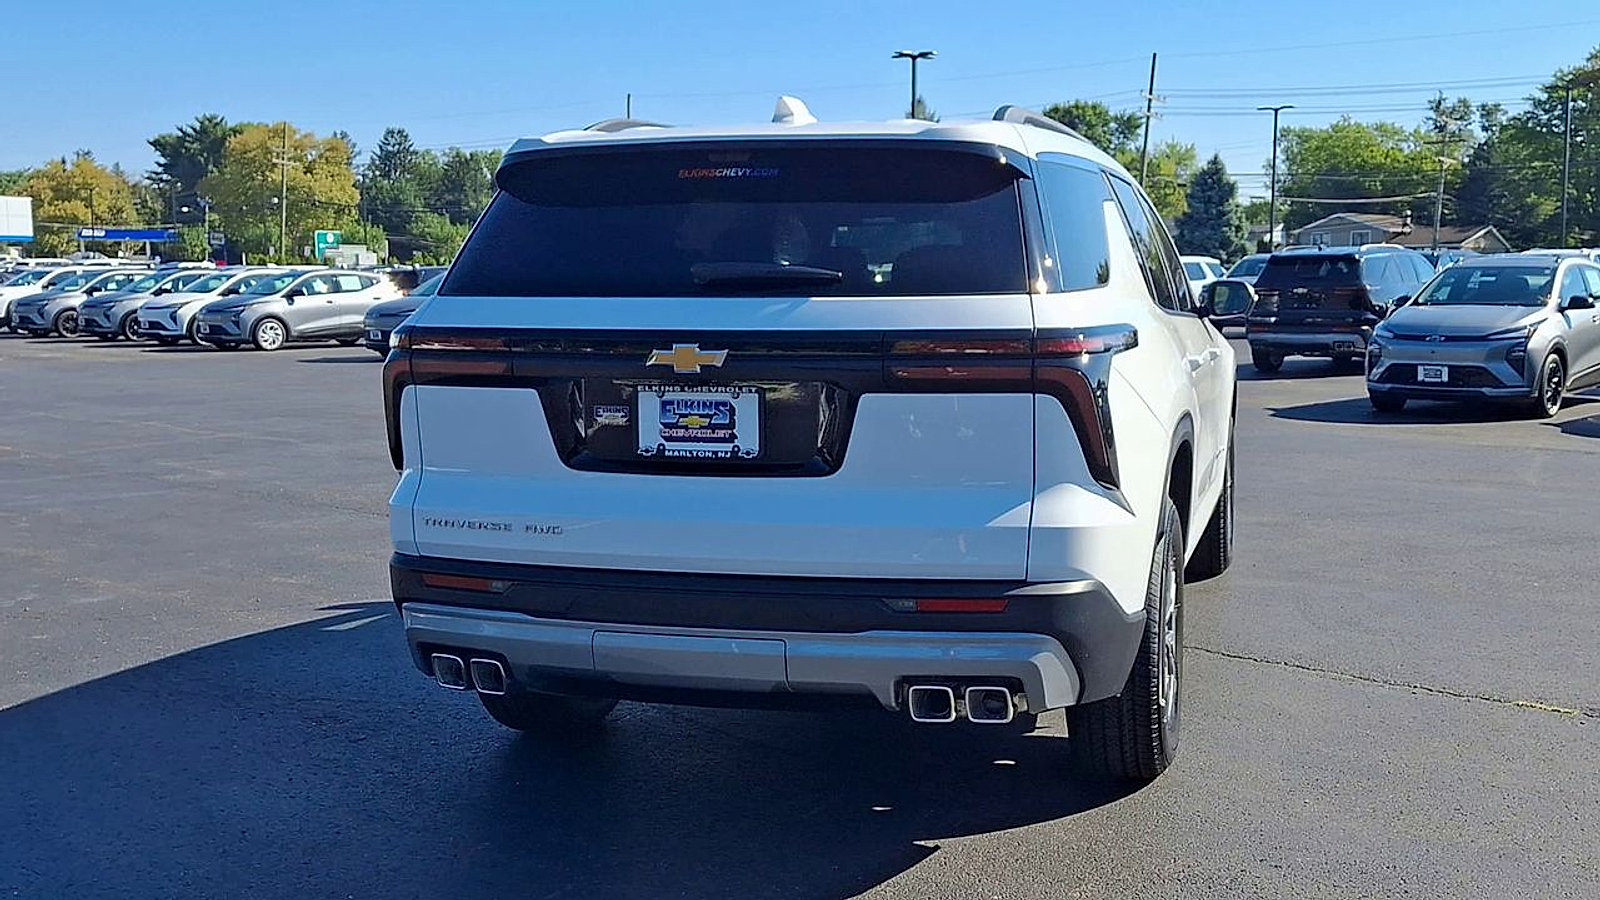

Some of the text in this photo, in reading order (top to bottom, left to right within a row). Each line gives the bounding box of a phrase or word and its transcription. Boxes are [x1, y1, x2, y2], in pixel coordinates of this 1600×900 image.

[679, 167, 779, 178] ELKINSCHEVY.COM
[637, 384, 758, 394] ELKINS CHEVROLET
[660, 399, 733, 424] ELKINS
[661, 428, 732, 438] CHEVROLET
[664, 449, 731, 458] MARLTON, NJ
[424, 516, 513, 532] TRAVERSE
